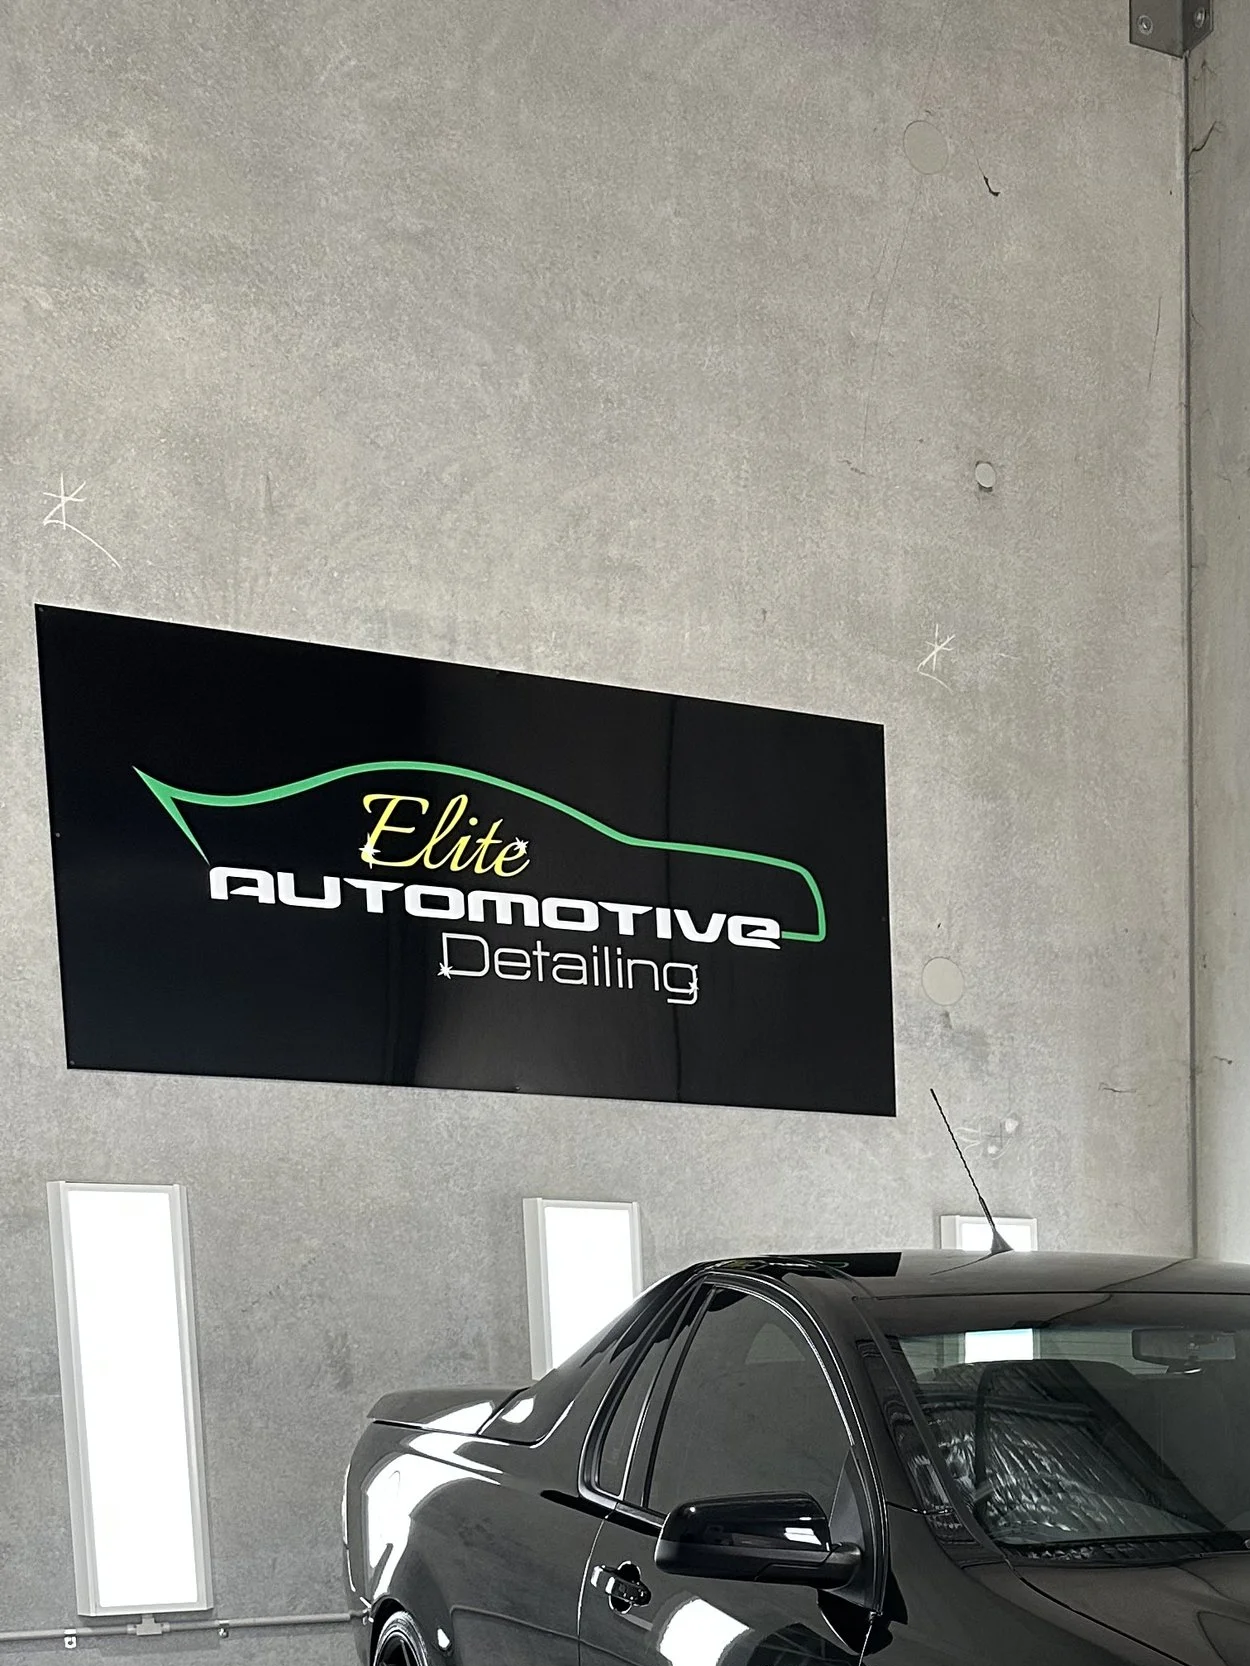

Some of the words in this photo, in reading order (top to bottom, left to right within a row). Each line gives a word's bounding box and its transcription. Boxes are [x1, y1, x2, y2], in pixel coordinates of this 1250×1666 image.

[361, 794, 530, 877] Elite
[209, 866, 781, 950] AUTOMOTIVE
[440, 932, 700, 1005] Detailing
